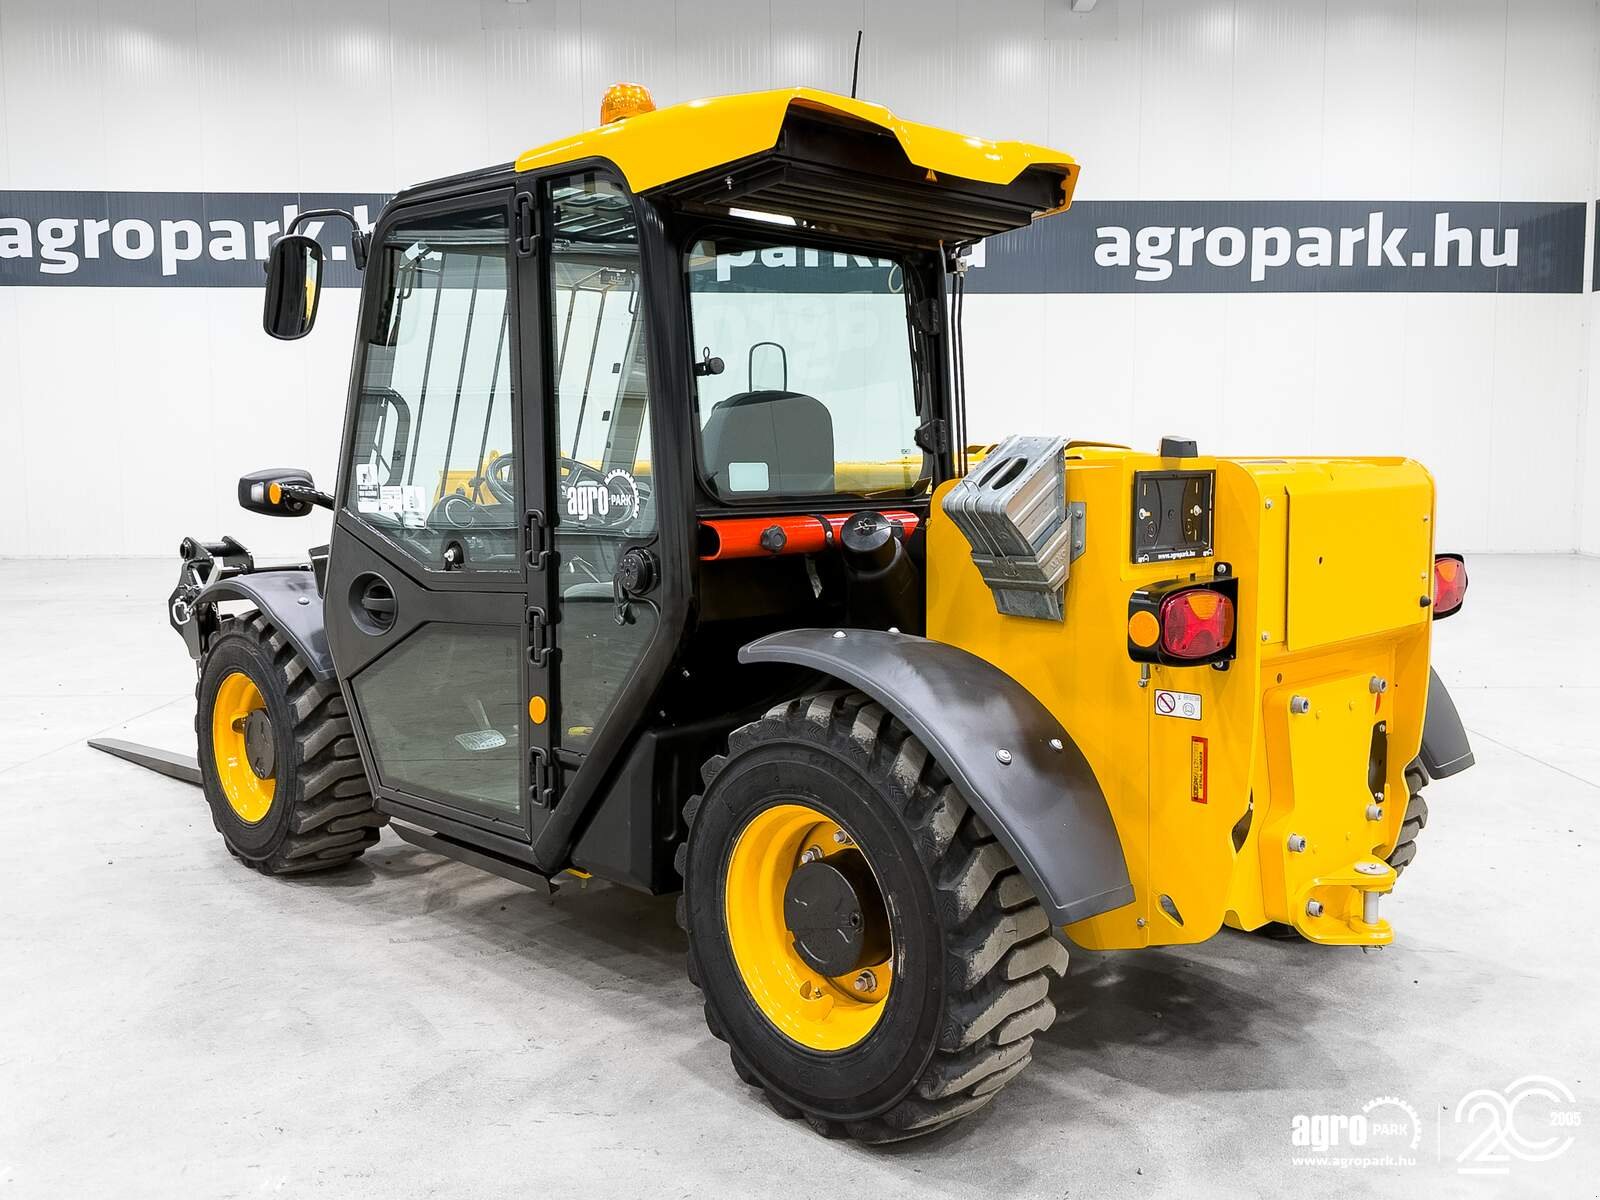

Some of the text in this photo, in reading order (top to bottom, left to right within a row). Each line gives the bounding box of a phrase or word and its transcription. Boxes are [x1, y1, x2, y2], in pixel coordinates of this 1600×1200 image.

[1094, 211, 1519, 282] agropark.hu
[567, 486, 632, 520] agro PARK
